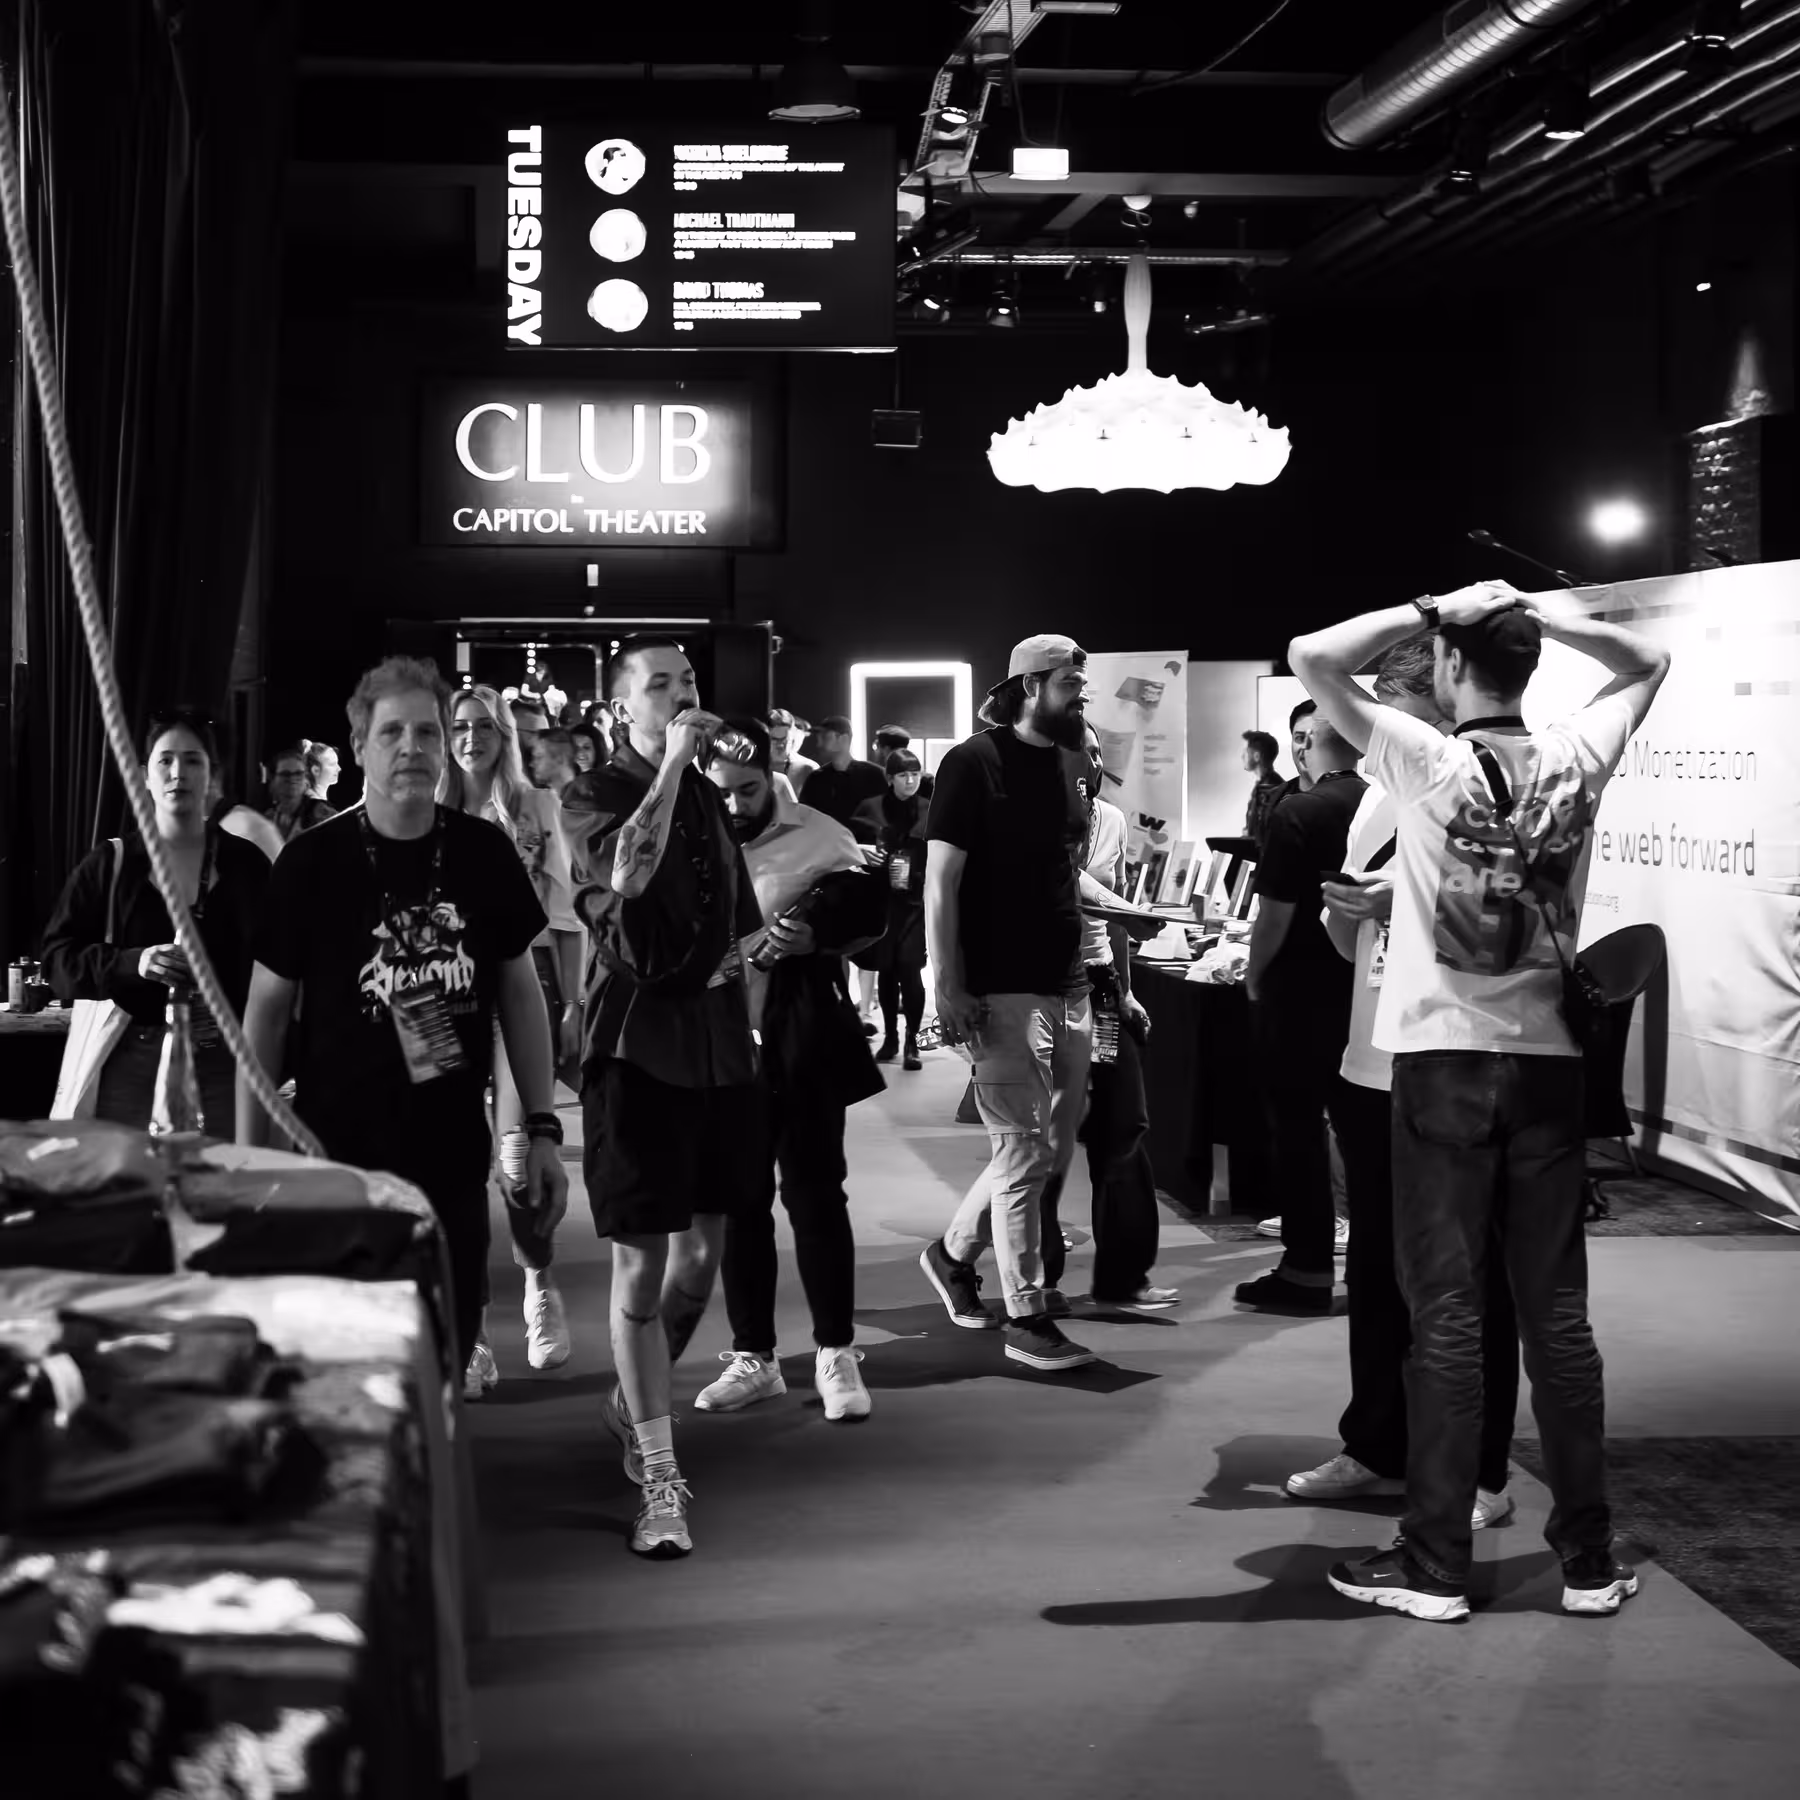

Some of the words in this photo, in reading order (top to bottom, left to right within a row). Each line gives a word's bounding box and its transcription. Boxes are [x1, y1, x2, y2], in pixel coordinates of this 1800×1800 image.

[508, 125, 542, 346] TUESDAY
[455, 402, 711, 484] CLUB
[452, 507, 574, 534] CAPITOL
[583, 509, 707, 535] THEATER
[1635, 740, 1757, 782] Monetization
[1619, 821, 1663, 866] web
[1670, 822, 1755, 877] forward
